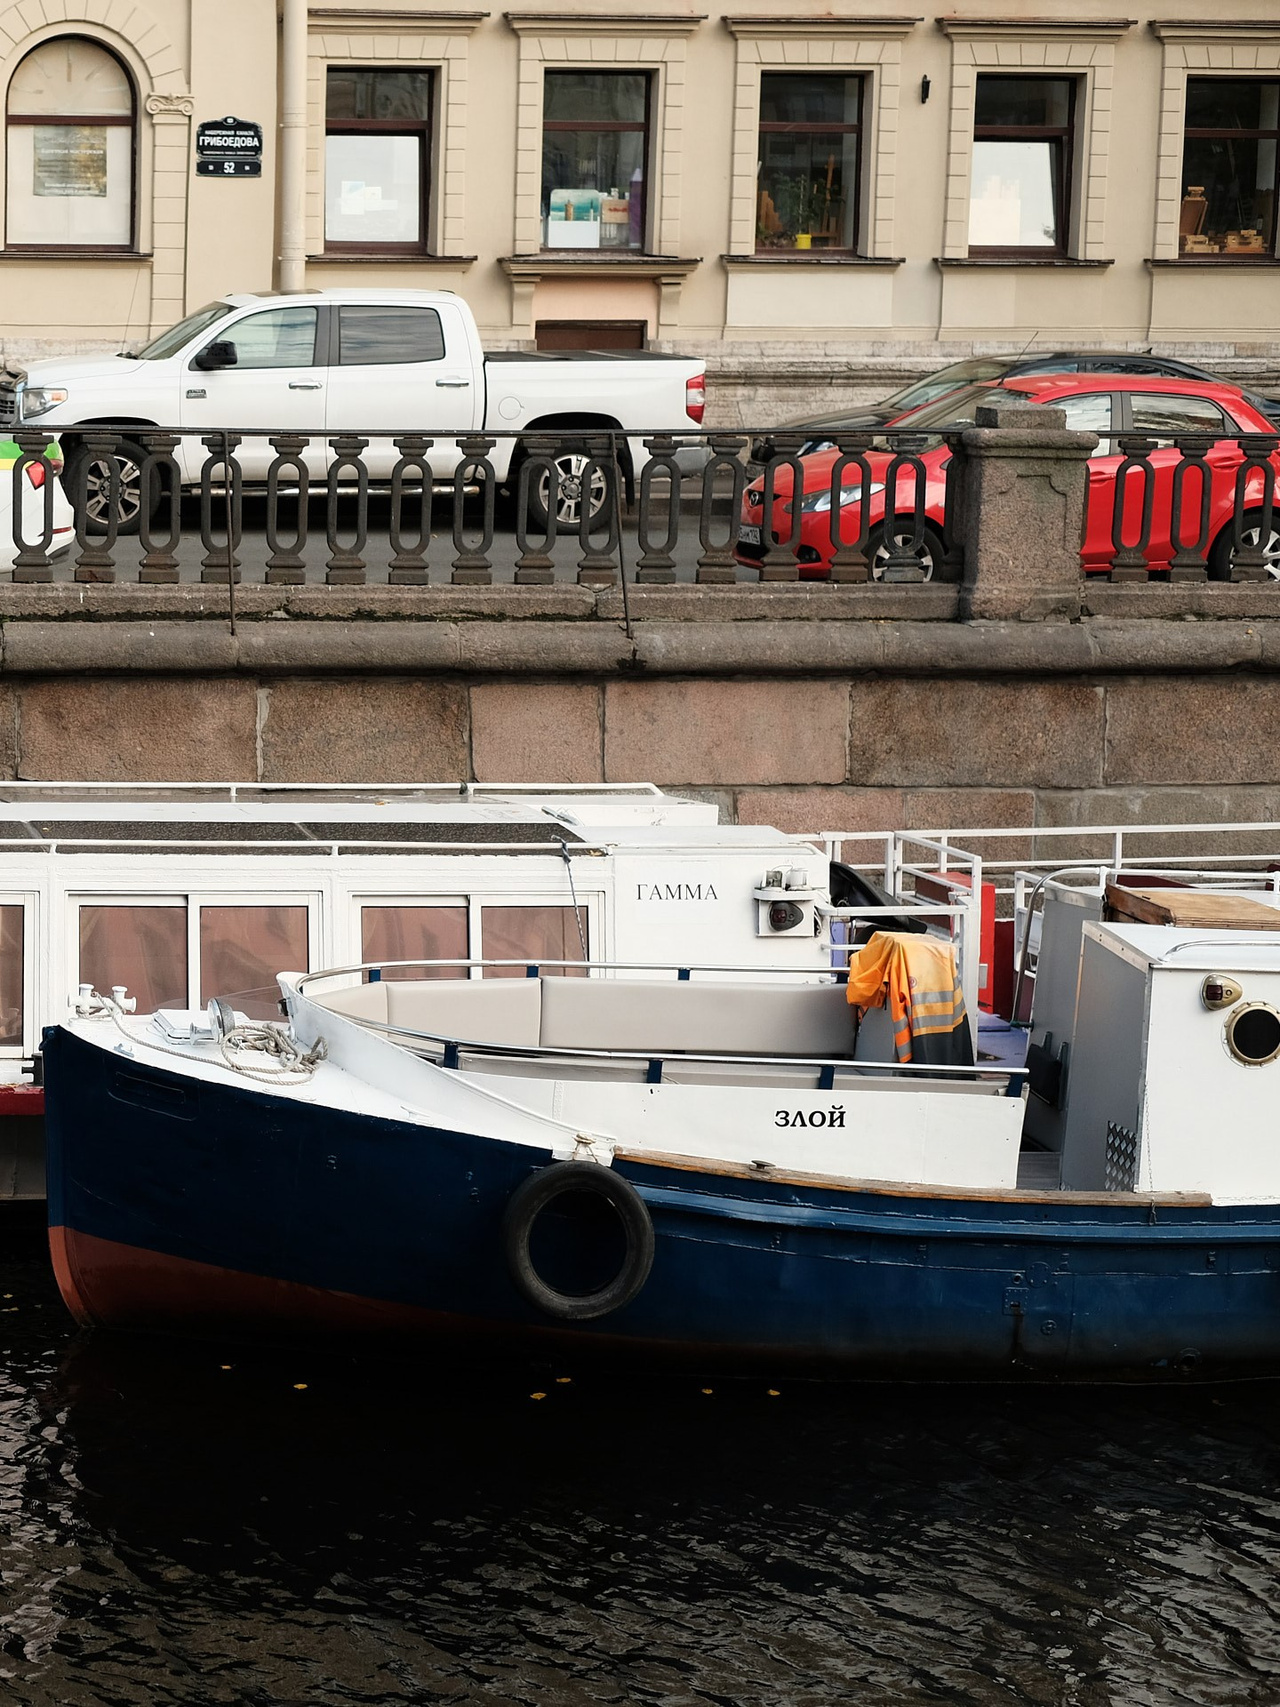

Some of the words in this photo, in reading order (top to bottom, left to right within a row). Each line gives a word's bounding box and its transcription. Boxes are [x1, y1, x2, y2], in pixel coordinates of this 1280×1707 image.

[199, 136, 260, 148] ГРИБОЕДОВА
[223, 162, 235, 173] 52
[636, 883, 718, 901] ГАММА
